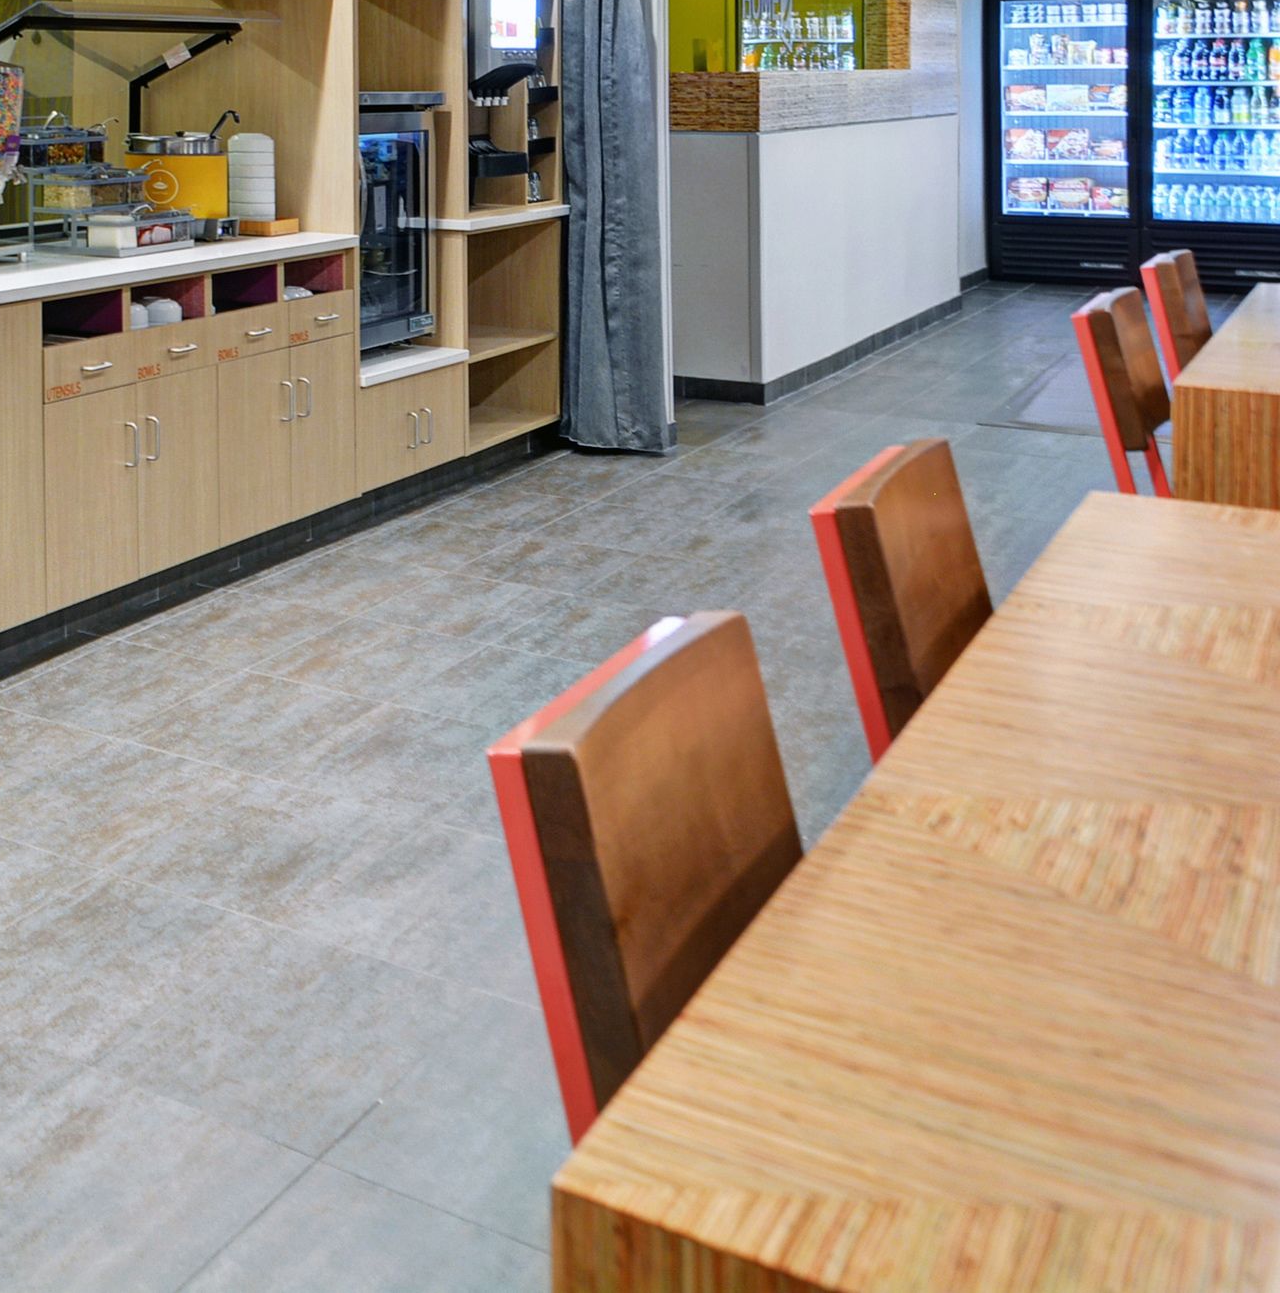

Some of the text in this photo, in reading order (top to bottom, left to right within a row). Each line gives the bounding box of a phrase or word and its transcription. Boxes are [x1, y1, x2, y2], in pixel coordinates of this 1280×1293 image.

[218, 347, 239, 361] BOWLS
[138, 364, 161, 379] BOWLS
[47, 381, 81, 401] UTENSILS
